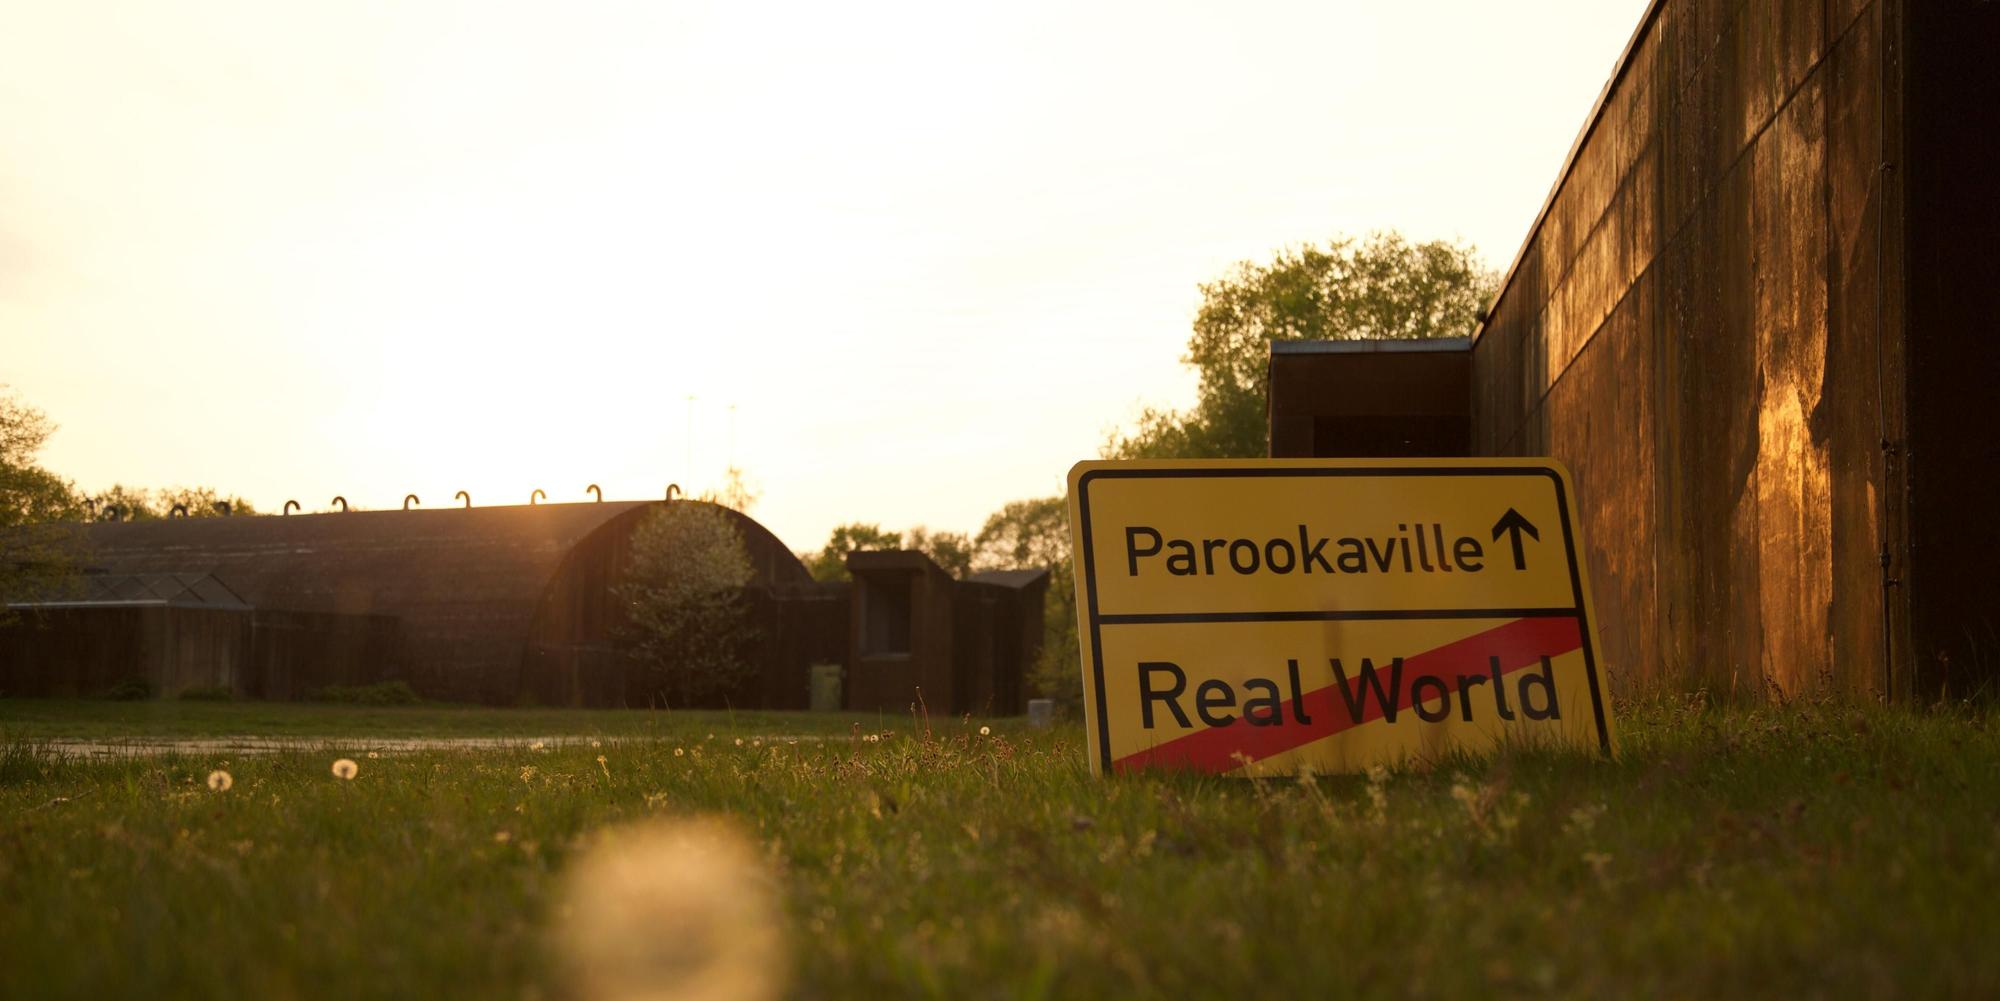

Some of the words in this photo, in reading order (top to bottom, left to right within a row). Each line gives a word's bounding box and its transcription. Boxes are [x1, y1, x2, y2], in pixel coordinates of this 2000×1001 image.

[1125, 523, 1484, 577] Parookaville
[1137, 658, 1312, 730] Real
[1329, 655, 1562, 725] World
